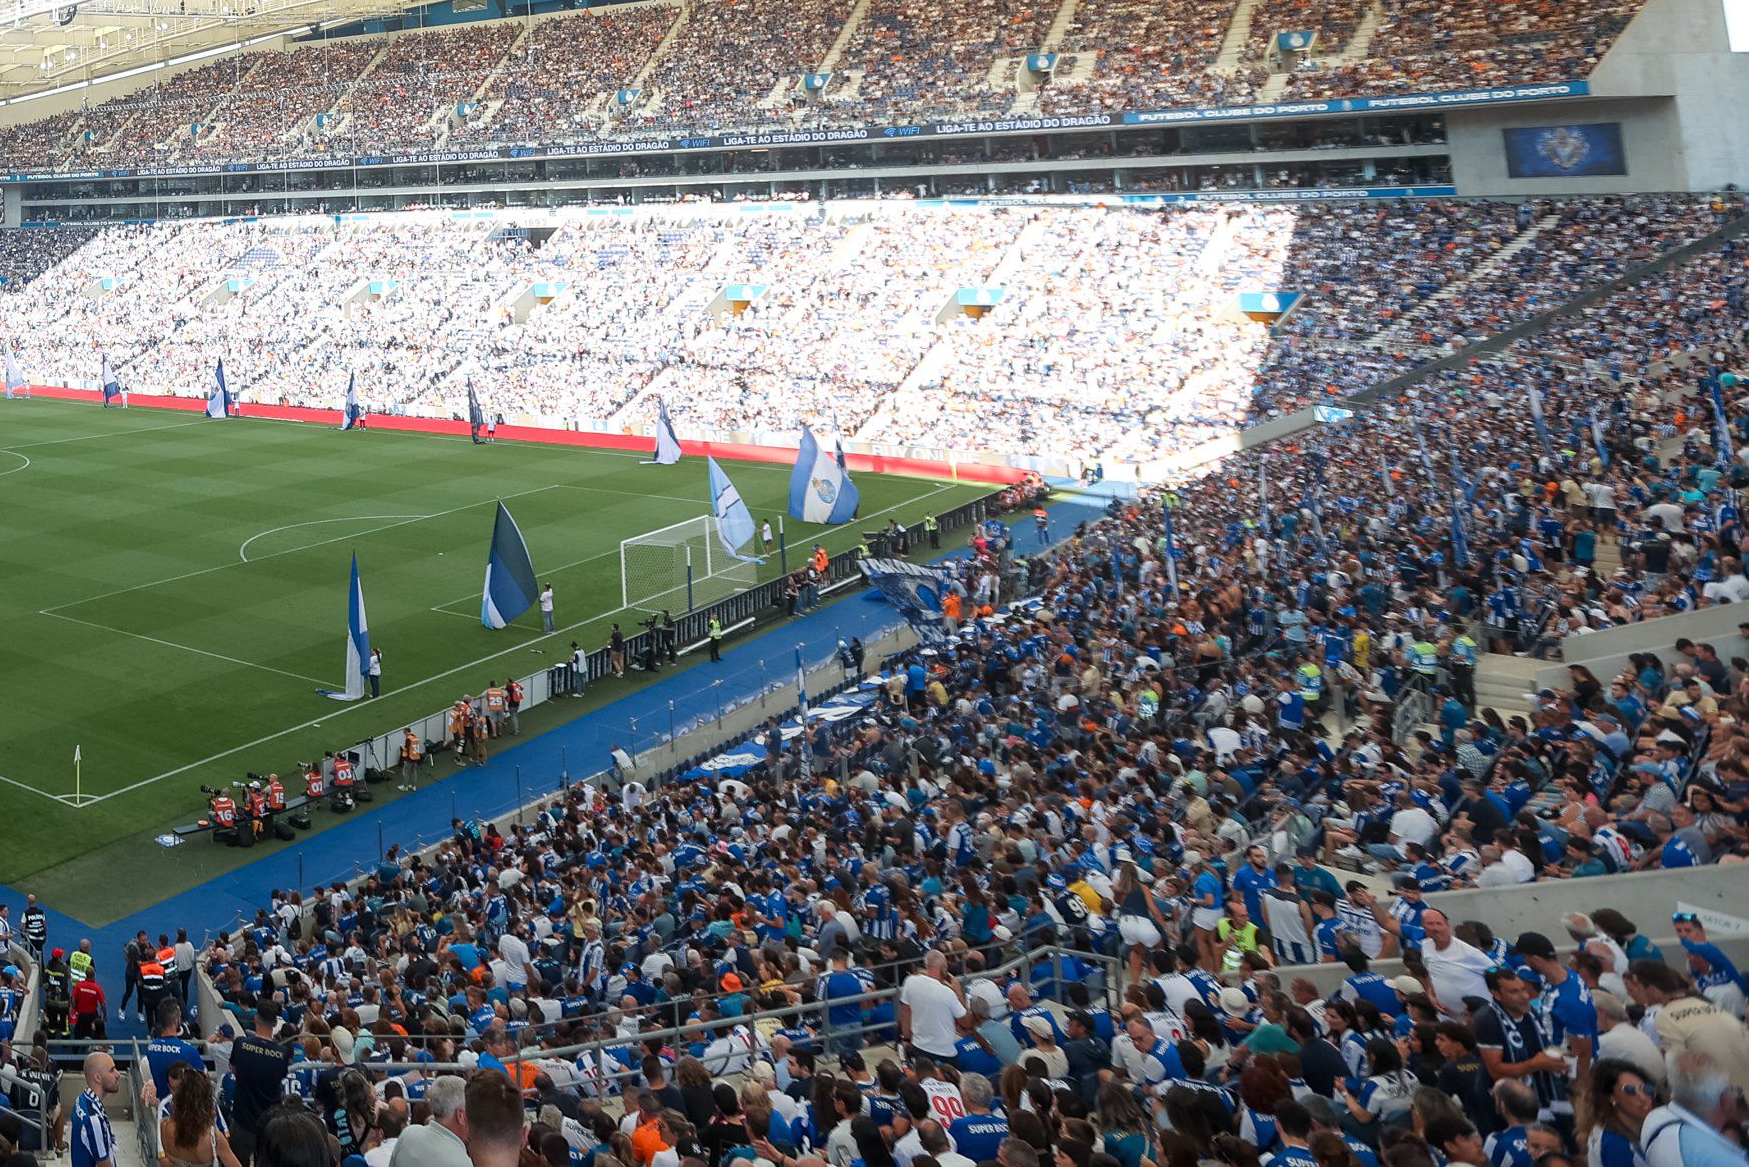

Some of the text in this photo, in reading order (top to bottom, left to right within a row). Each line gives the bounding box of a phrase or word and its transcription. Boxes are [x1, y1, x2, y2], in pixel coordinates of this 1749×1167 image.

[1368, 86, 1570, 108] FUTEBOL CLUBE DO PORTO
[1139, 104, 1328, 121] FUTEBOL CLUBE DO PORTO
[936, 122, 976, 134] LIGA-TE
[978, 121, 993, 132] AO
[995, 118, 1041, 131] ESTÁDIO
[1043, 117, 1059, 128] DO
[1061, 114, 1110, 128] DRAGÃO
[723, 134, 756, 146] LIGA-TE
[758, 134, 770, 144] AO
[772, 132, 810, 143] ESTÁDIO
[812, 131, 825, 141] DO
[826, 128, 867, 140] DRAGÃO
[547, 145, 575, 156] LIGA-TE
[576, 144, 587, 154] AO
[588, 142, 621, 153] ESTÁDIO
[622, 142, 633, 152] DO
[634, 140, 669, 151] DRAGÃO
[392, 154, 417, 163] LIGA-TE
[417, 153, 427, 162] AO
[428, 152, 456, 162] ESTÁDIO
[457, 151, 467, 160] DO
[468, 150, 498, 160] DRAGÃO
[256, 162, 278, 170] LIGA-TE
[278, 161, 287, 169] AO
[287, 160, 312, 169] ESTÁDIO
[313, 159, 322, 168] DO
[322, 158, 349, 167] DRAGÃO
[1196, 190, 1368, 201] FUTEBOL CLUBE DO PORTO
[337, 768, 352, 781] 03
[217, 809, 233, 822] 16
[164, 1045, 181, 1054] BOCK
[241, 1042, 284, 1060] SUPER BOCK
[968, 1123, 992, 1135] SUPER
